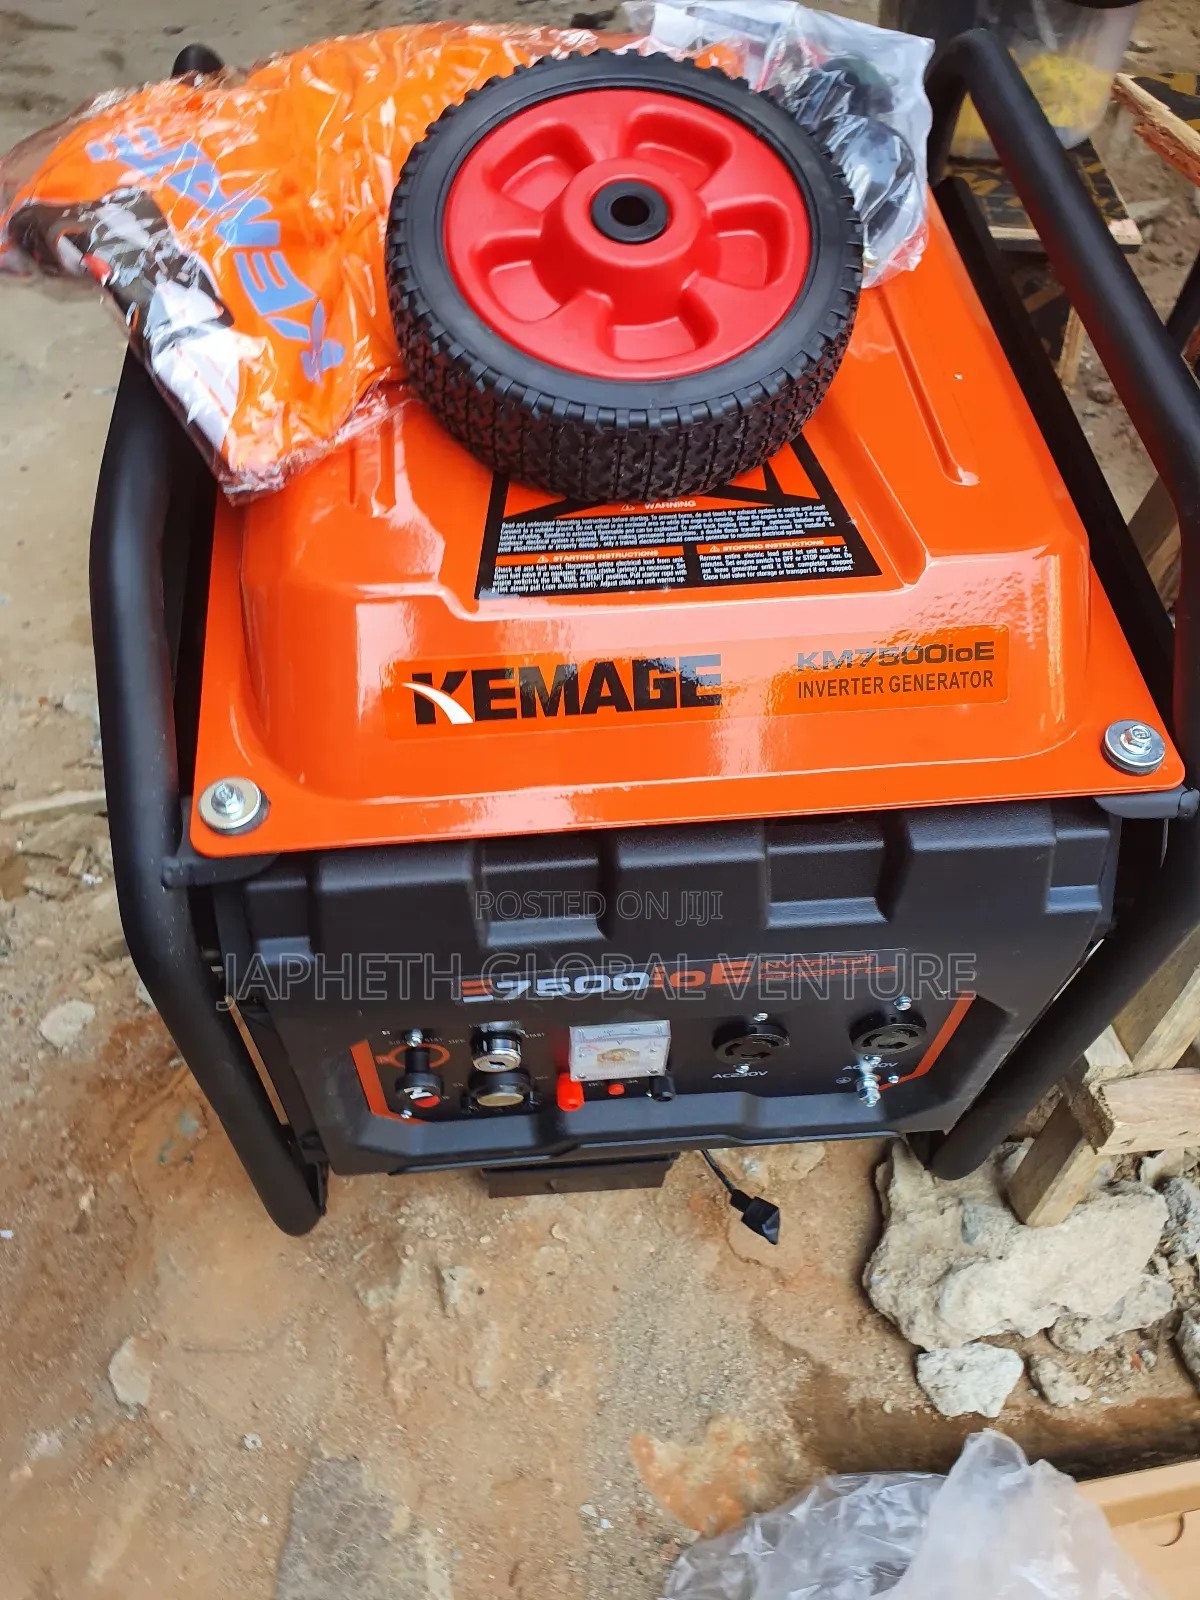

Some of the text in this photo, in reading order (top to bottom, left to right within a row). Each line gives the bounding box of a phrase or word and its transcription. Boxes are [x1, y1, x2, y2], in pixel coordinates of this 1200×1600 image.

[644, 501, 697, 510] WARNING
[723, 540, 825, 552] STOPPING INSTRUCTIONS
[553, 550, 659, 562] STARTING INSTRUCTIONS
[699, 554, 722, 562] Remove
[736, 559, 755, 567] engine
[819, 553, 842, 561] position.
[797, 561, 827, 569] completely
[756, 570, 777, 578] storage
[786, 568, 812, 576] transport
[826, 565, 853, 573] equipped.
[797, 641, 995, 671] KM7500ioE
[405, 654, 721, 724] KEMAGE
[798, 670, 994, 698] INVERTER GENERATOR
[842, 1062, 898, 1071] AC0V
